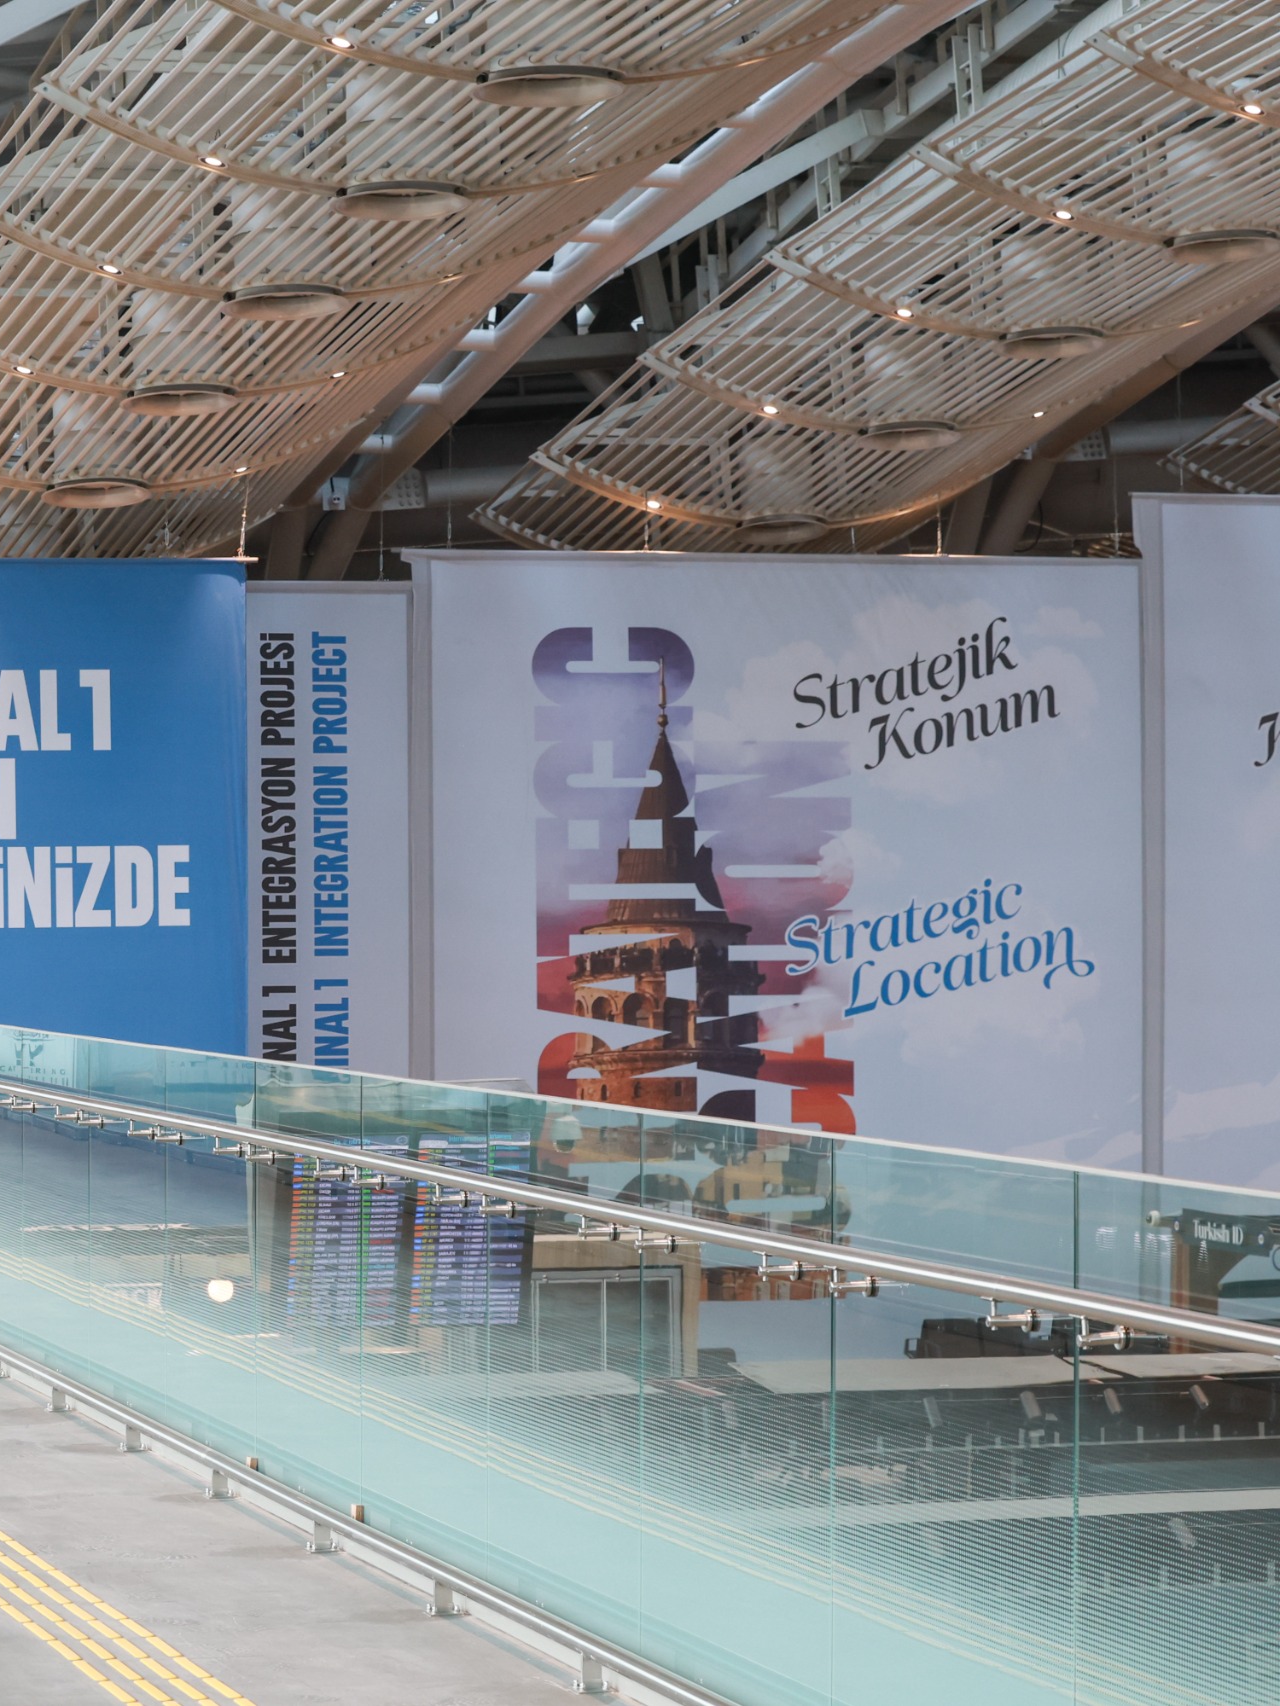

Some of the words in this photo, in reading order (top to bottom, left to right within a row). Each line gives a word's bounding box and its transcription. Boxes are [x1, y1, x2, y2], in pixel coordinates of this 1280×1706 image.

[79, 669, 112, 751] 1
[312, 631, 348, 754] PROJECT
[793, 617, 1018, 729] Stratejik
[864, 685, 1061, 770] Konum
[261, 757, 297, 964] ENTEGRASYON
[313, 765, 349, 957] INTEGRATION
[785, 877, 1024, 974] Strategic
[261, 985, 297, 997] 1
[313, 978, 349, 991] 1
[844, 926, 1096, 1018] Location
[1192, 1219, 1231, 1244] Turkish
